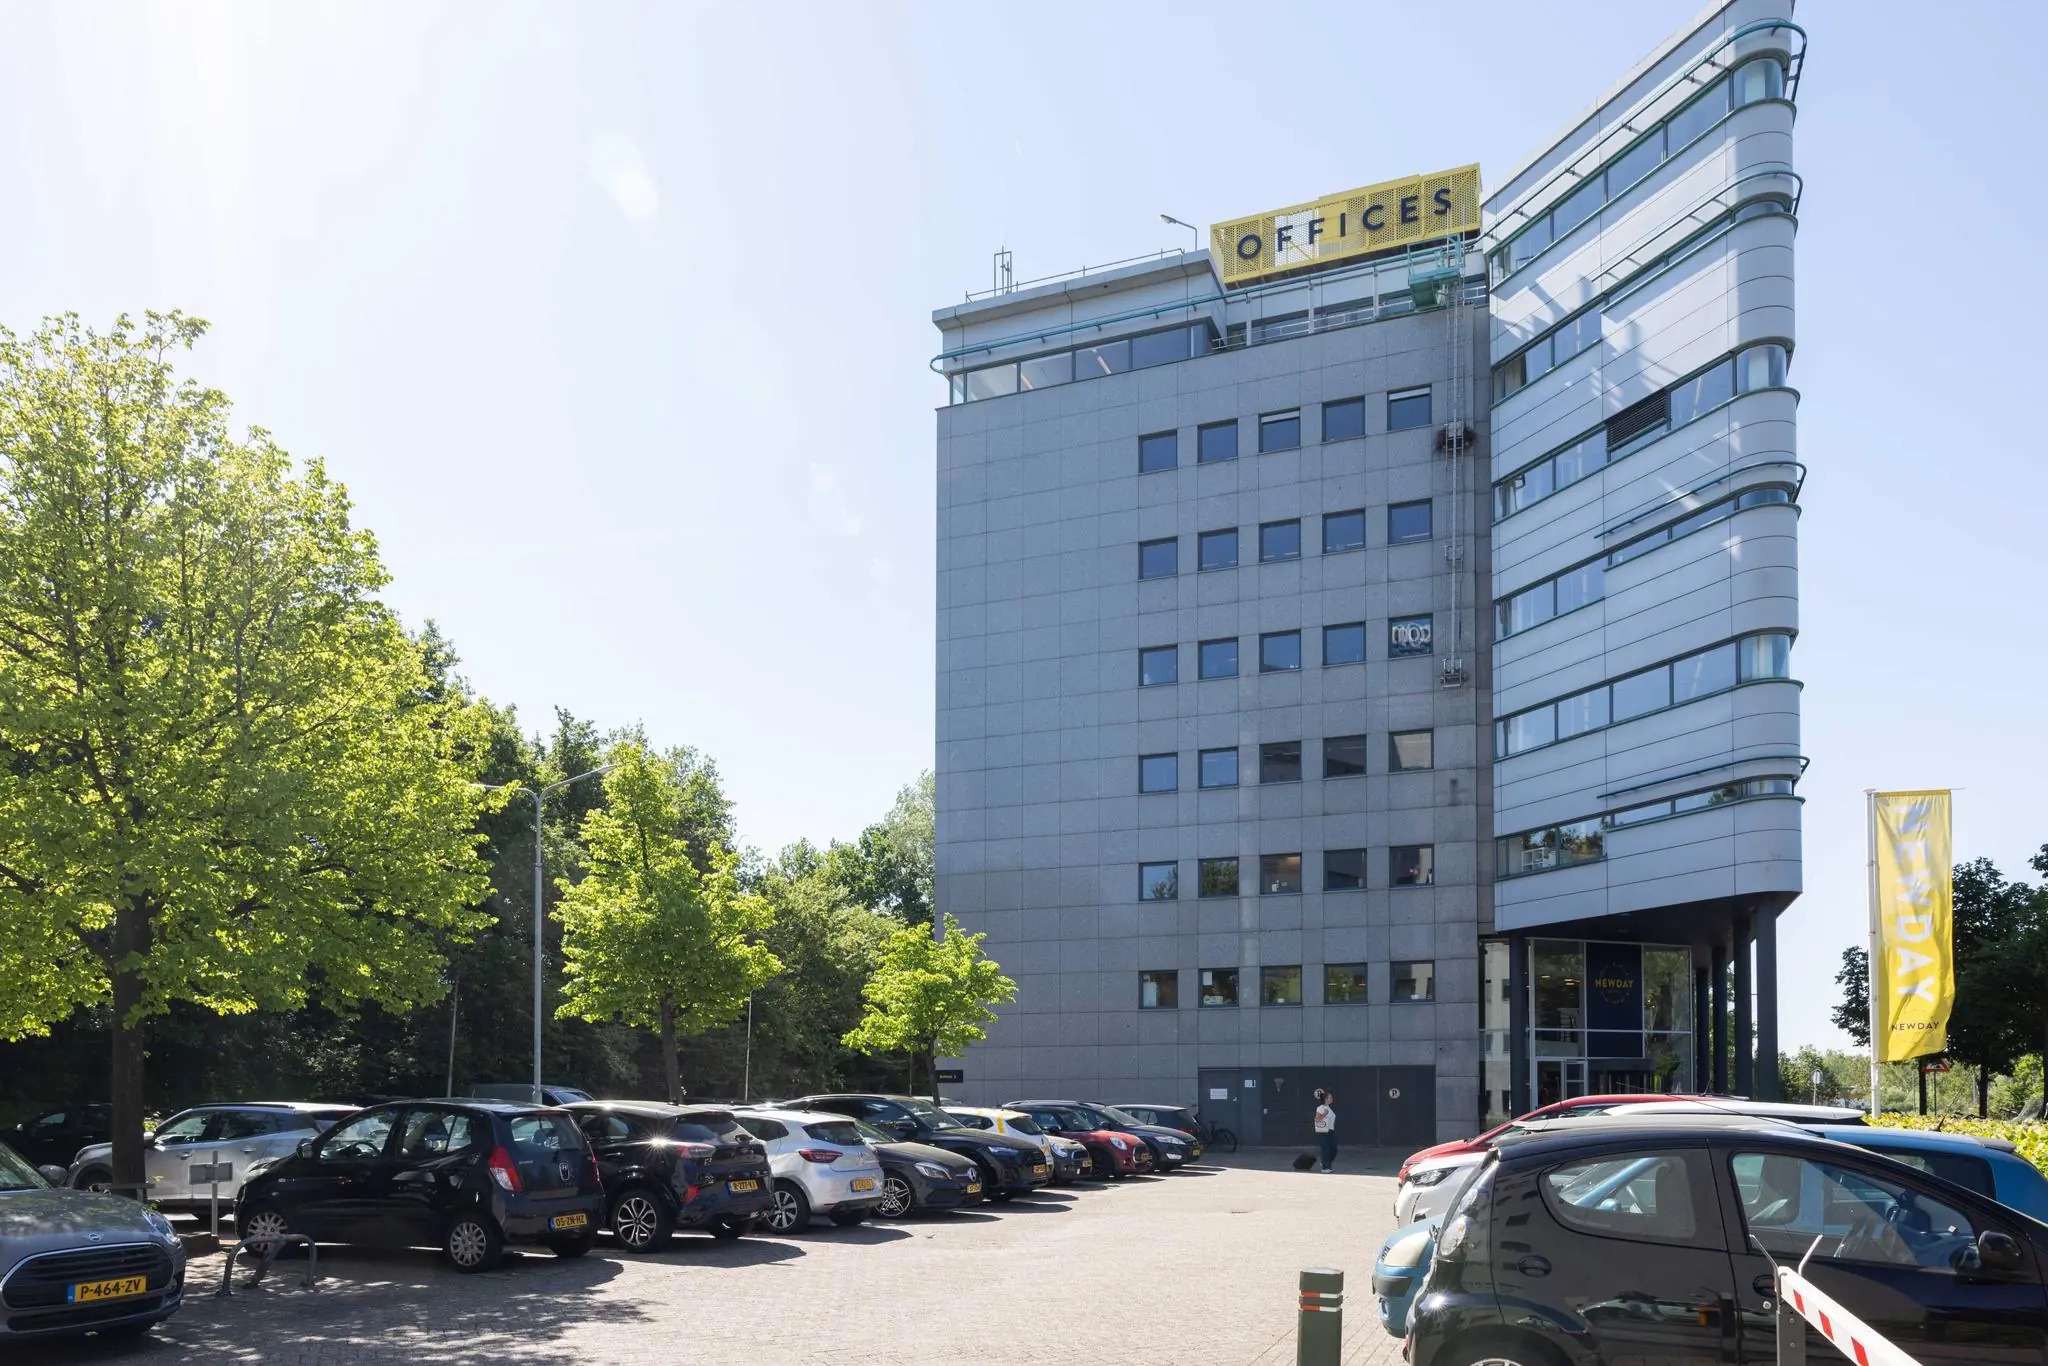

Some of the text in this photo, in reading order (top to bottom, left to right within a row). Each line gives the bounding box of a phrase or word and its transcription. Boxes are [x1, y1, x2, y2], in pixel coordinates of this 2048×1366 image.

[1237, 188, 1451, 260] OFFICES
[1594, 978, 1634, 989] NEWDAY
[1891, 1020, 1941, 1032] NEWDAY
[80, 1279, 142, 1299] P-464-ZV
